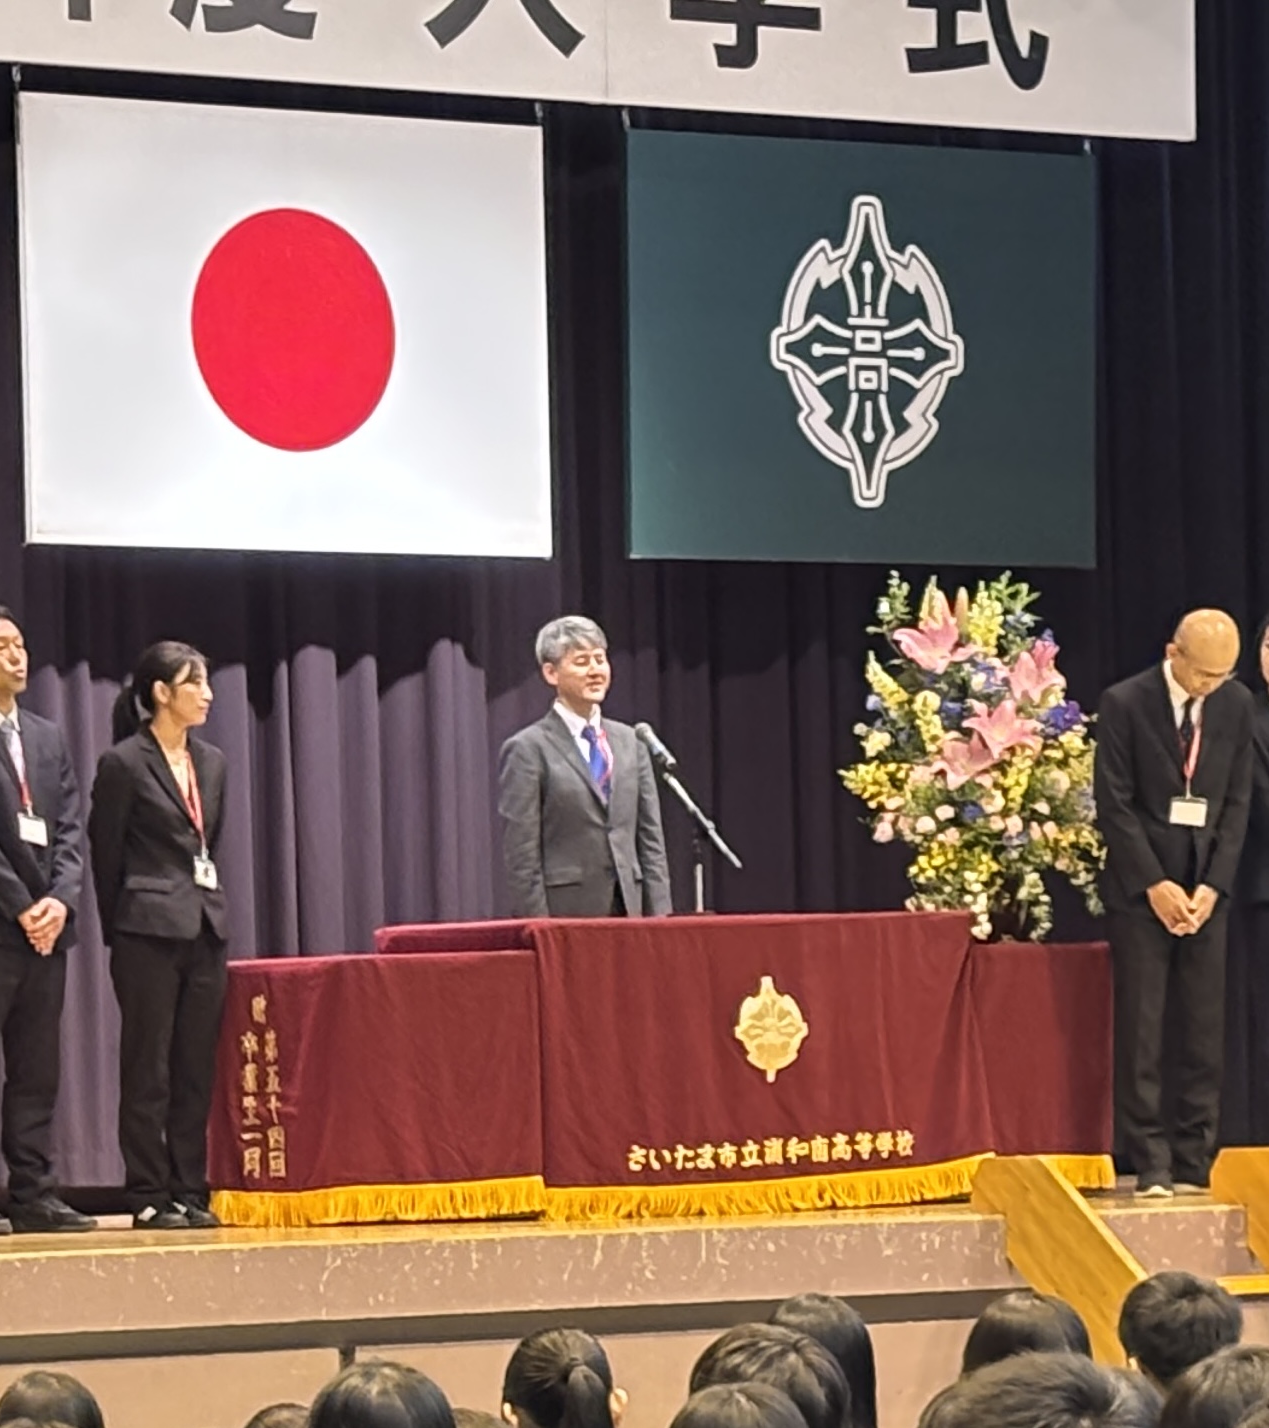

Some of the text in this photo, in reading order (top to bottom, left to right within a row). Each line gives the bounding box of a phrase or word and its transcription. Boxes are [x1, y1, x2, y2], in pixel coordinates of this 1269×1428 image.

[628, 1129, 916, 1172] さいたま市立浦和南高等学校
